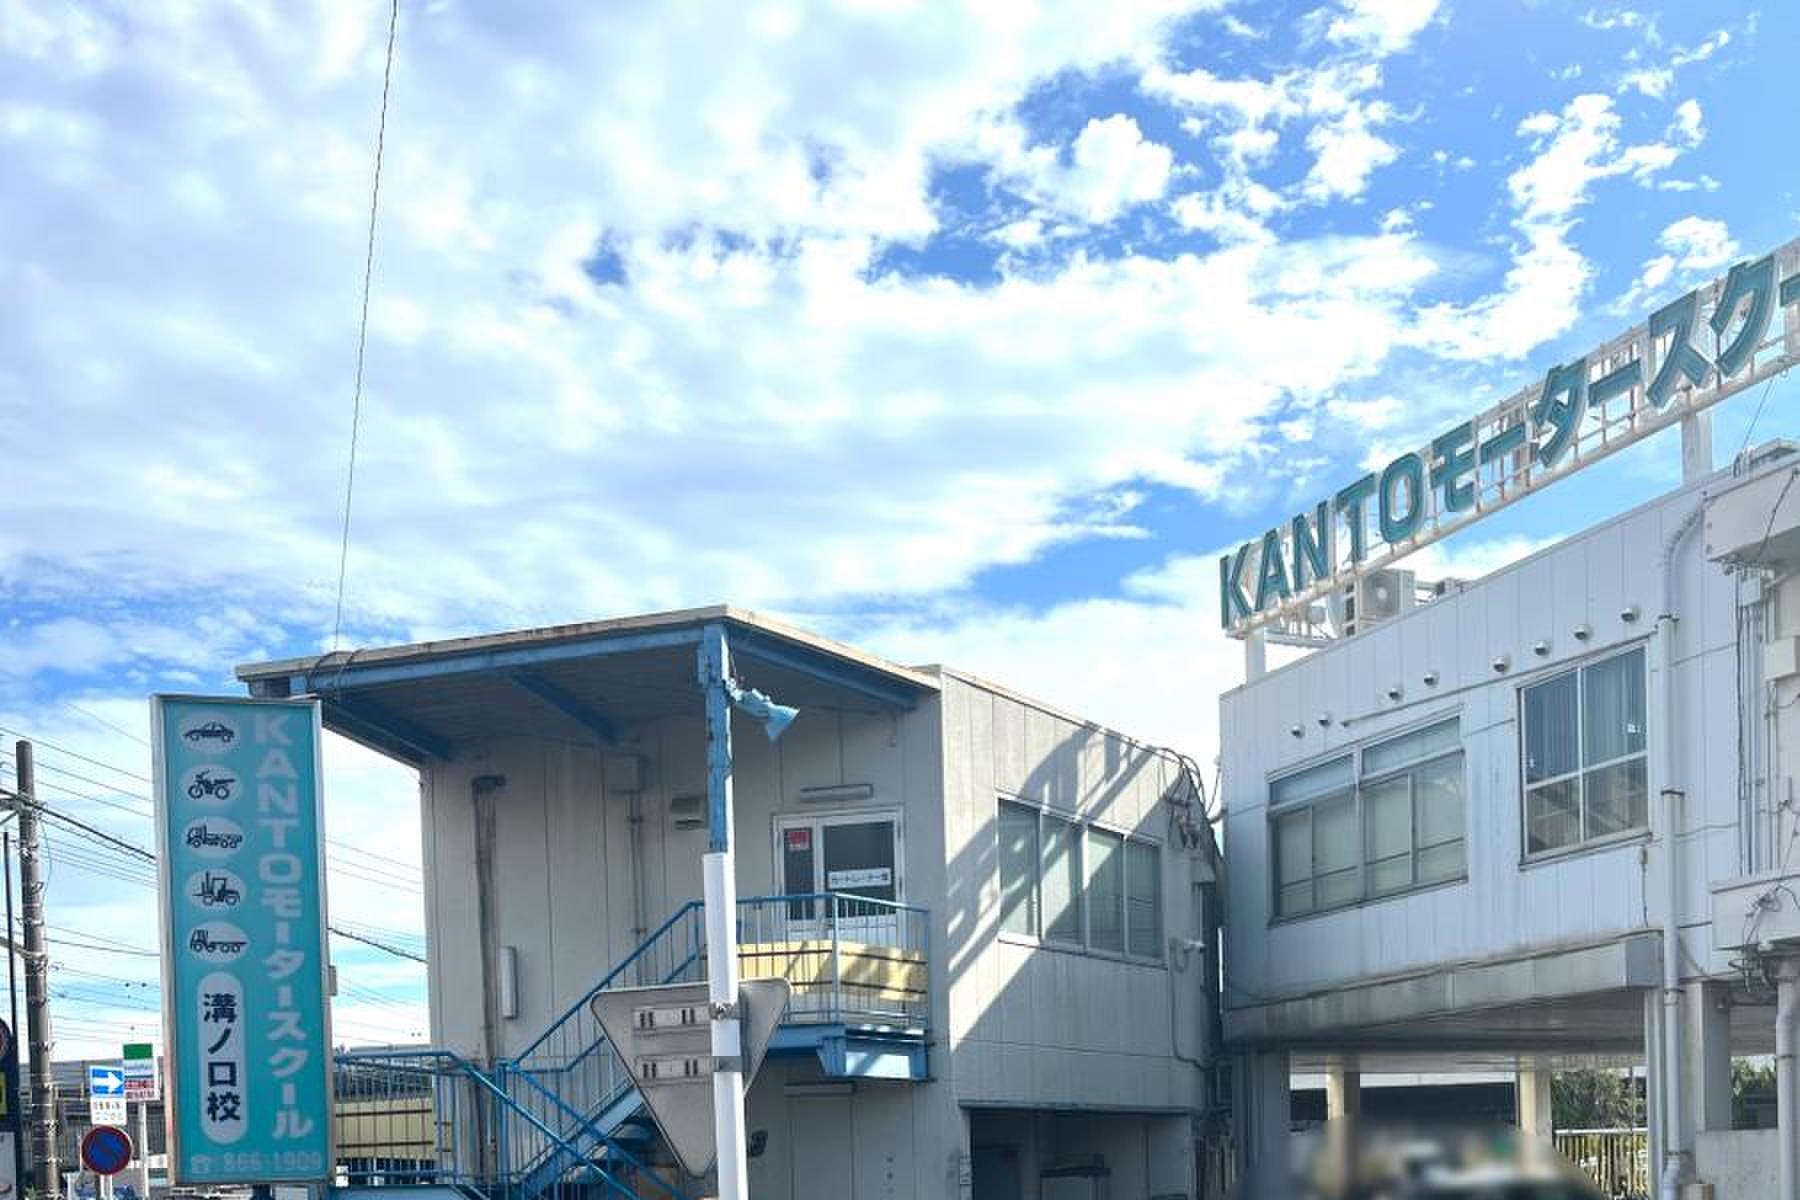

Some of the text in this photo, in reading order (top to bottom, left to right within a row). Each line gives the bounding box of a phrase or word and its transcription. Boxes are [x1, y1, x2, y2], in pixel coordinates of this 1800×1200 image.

[203, 993, 242, 1123] 溝ノ口校
[255, 712, 314, 1140] KANTOモータースクール
